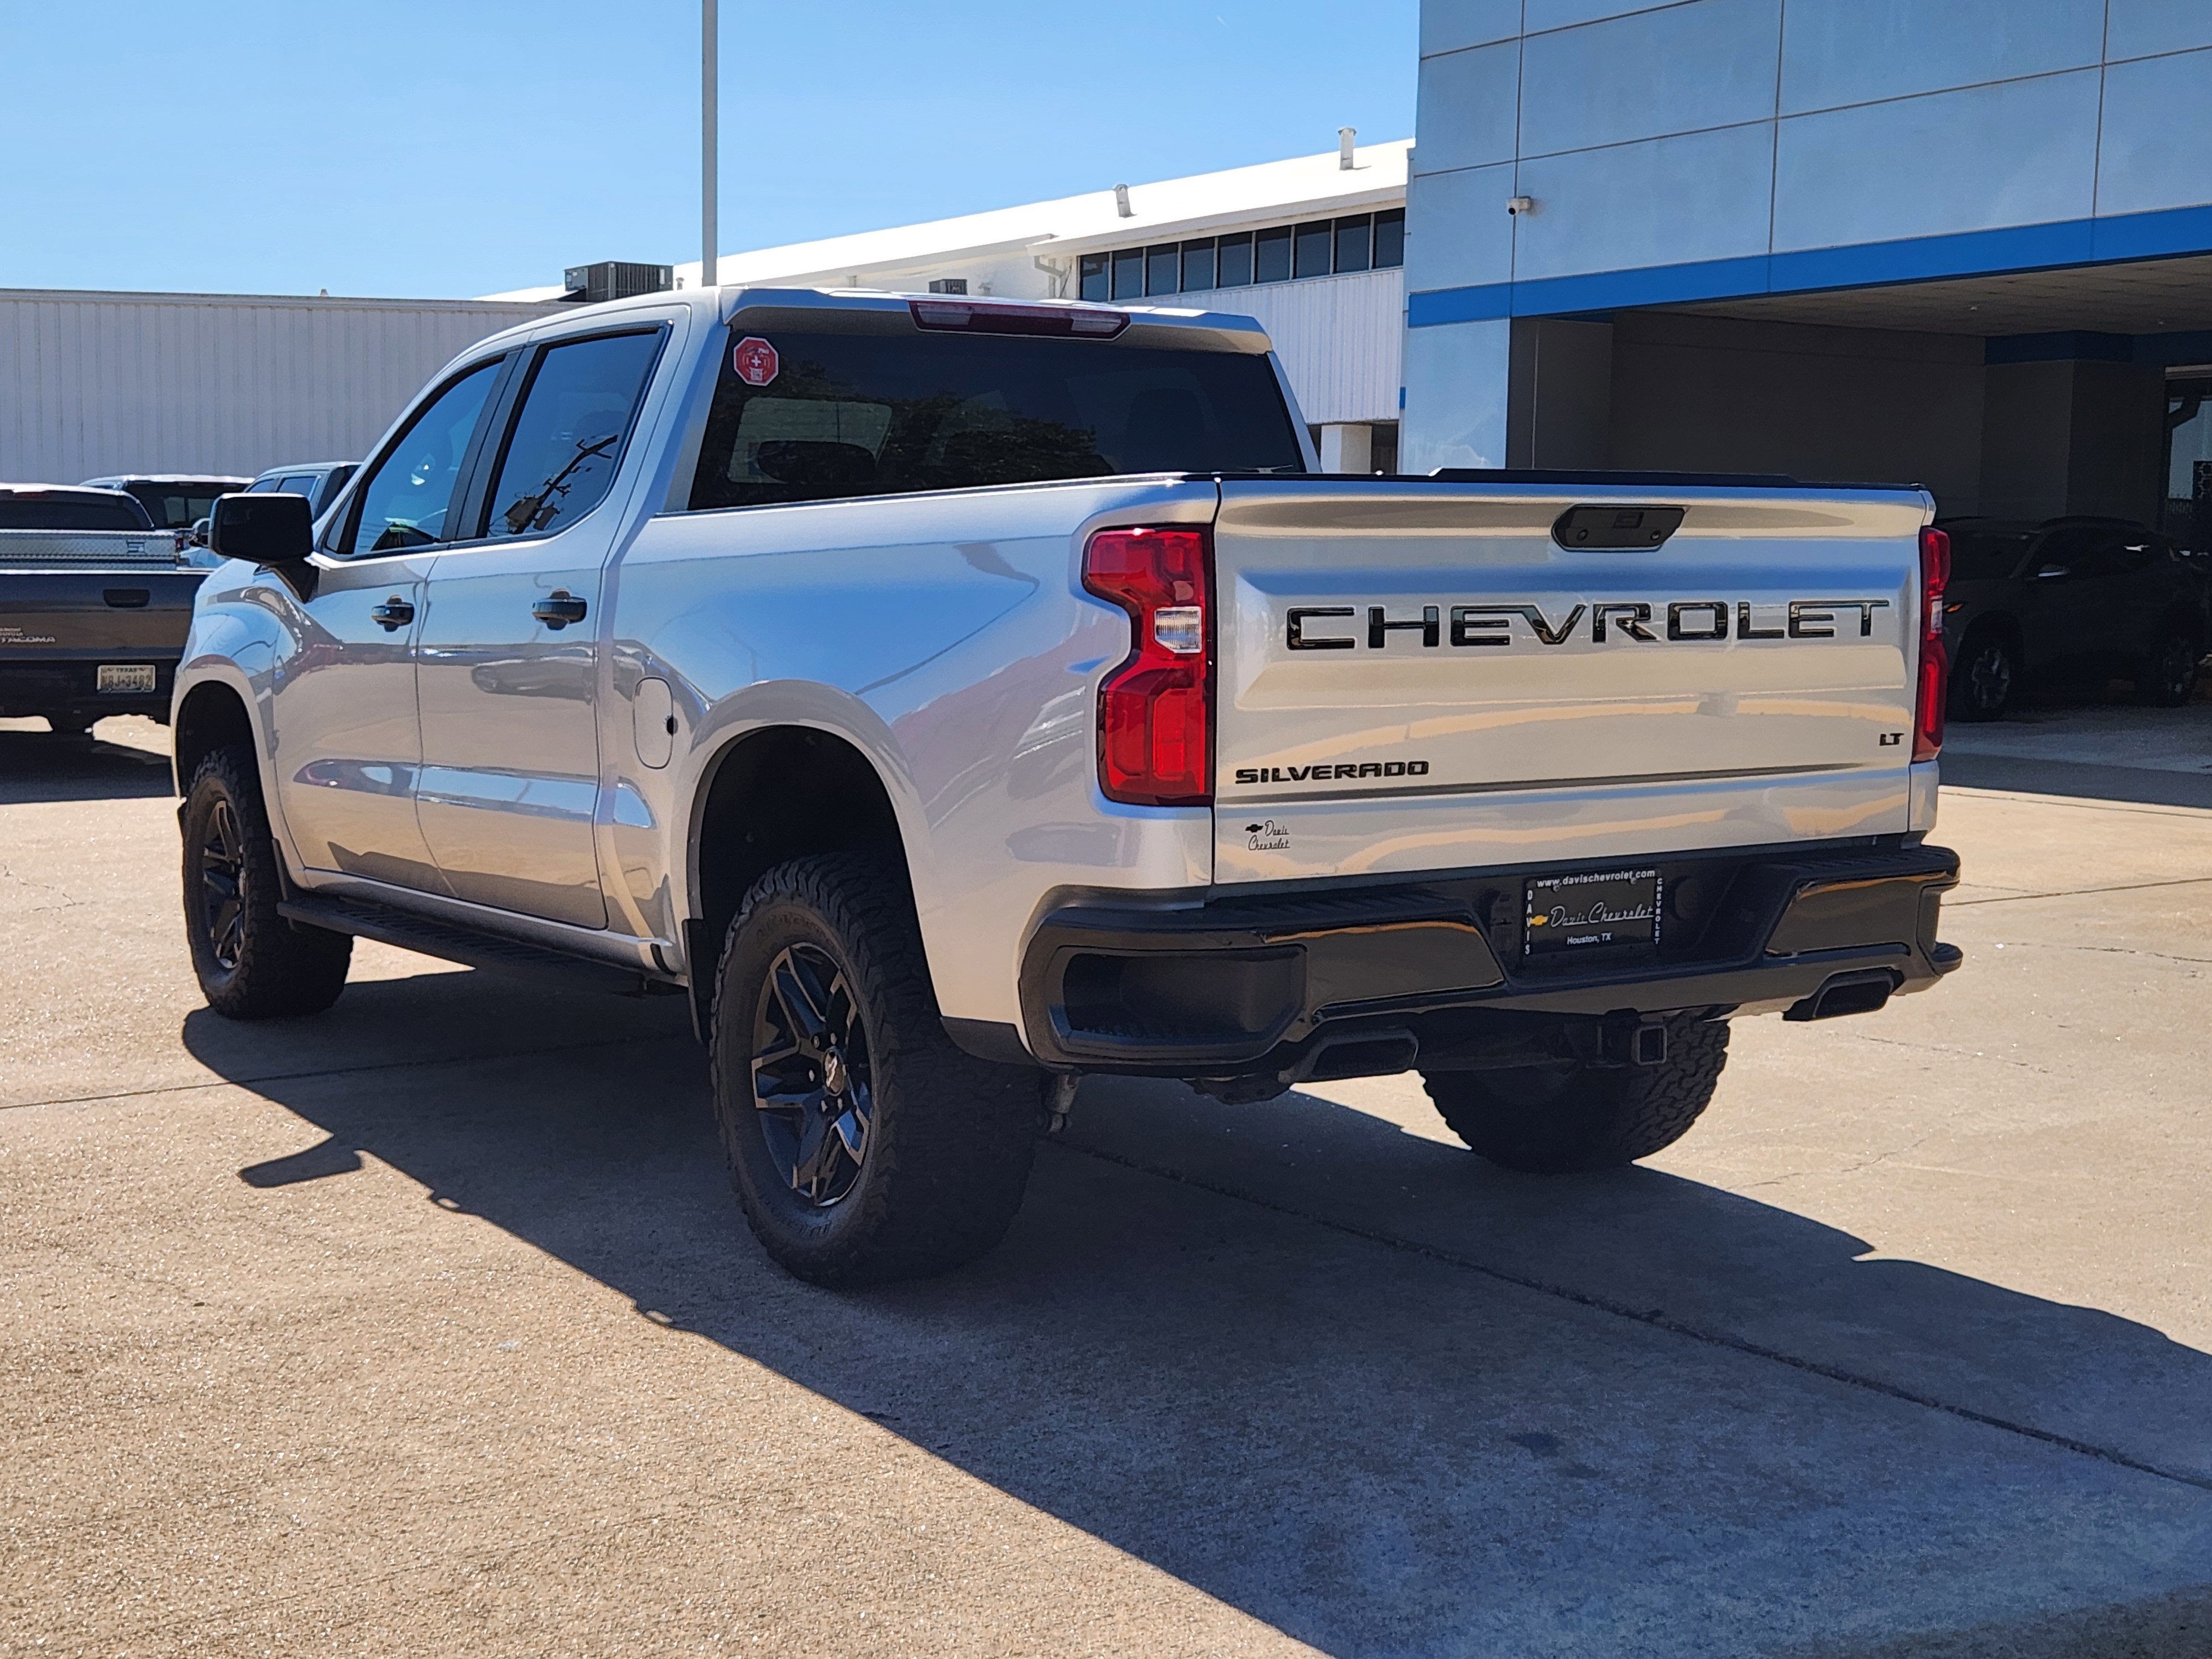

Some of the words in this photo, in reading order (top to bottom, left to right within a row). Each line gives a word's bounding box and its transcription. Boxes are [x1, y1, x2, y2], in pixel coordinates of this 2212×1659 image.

[1287, 599, 1889, 650] CHEVROLET
[1879, 733, 1905, 746] LT
[1235, 761, 1429, 784] SILVERADO
[1265, 820, 1290, 837] Davis
[1248, 834, 1291, 851] Chevrolet
[1537, 870, 1655, 888] www.davischevrolet.com
[1550, 906, 1588, 927] Davis
[1588, 901, 1654, 924] Chevrolet
[1654, 877, 1663, 945] CHEVROLET
[1525, 889, 1533, 955] DAVIS
[1567, 935, 1599, 945] Houston,
[1601, 932, 1611, 941] TX
